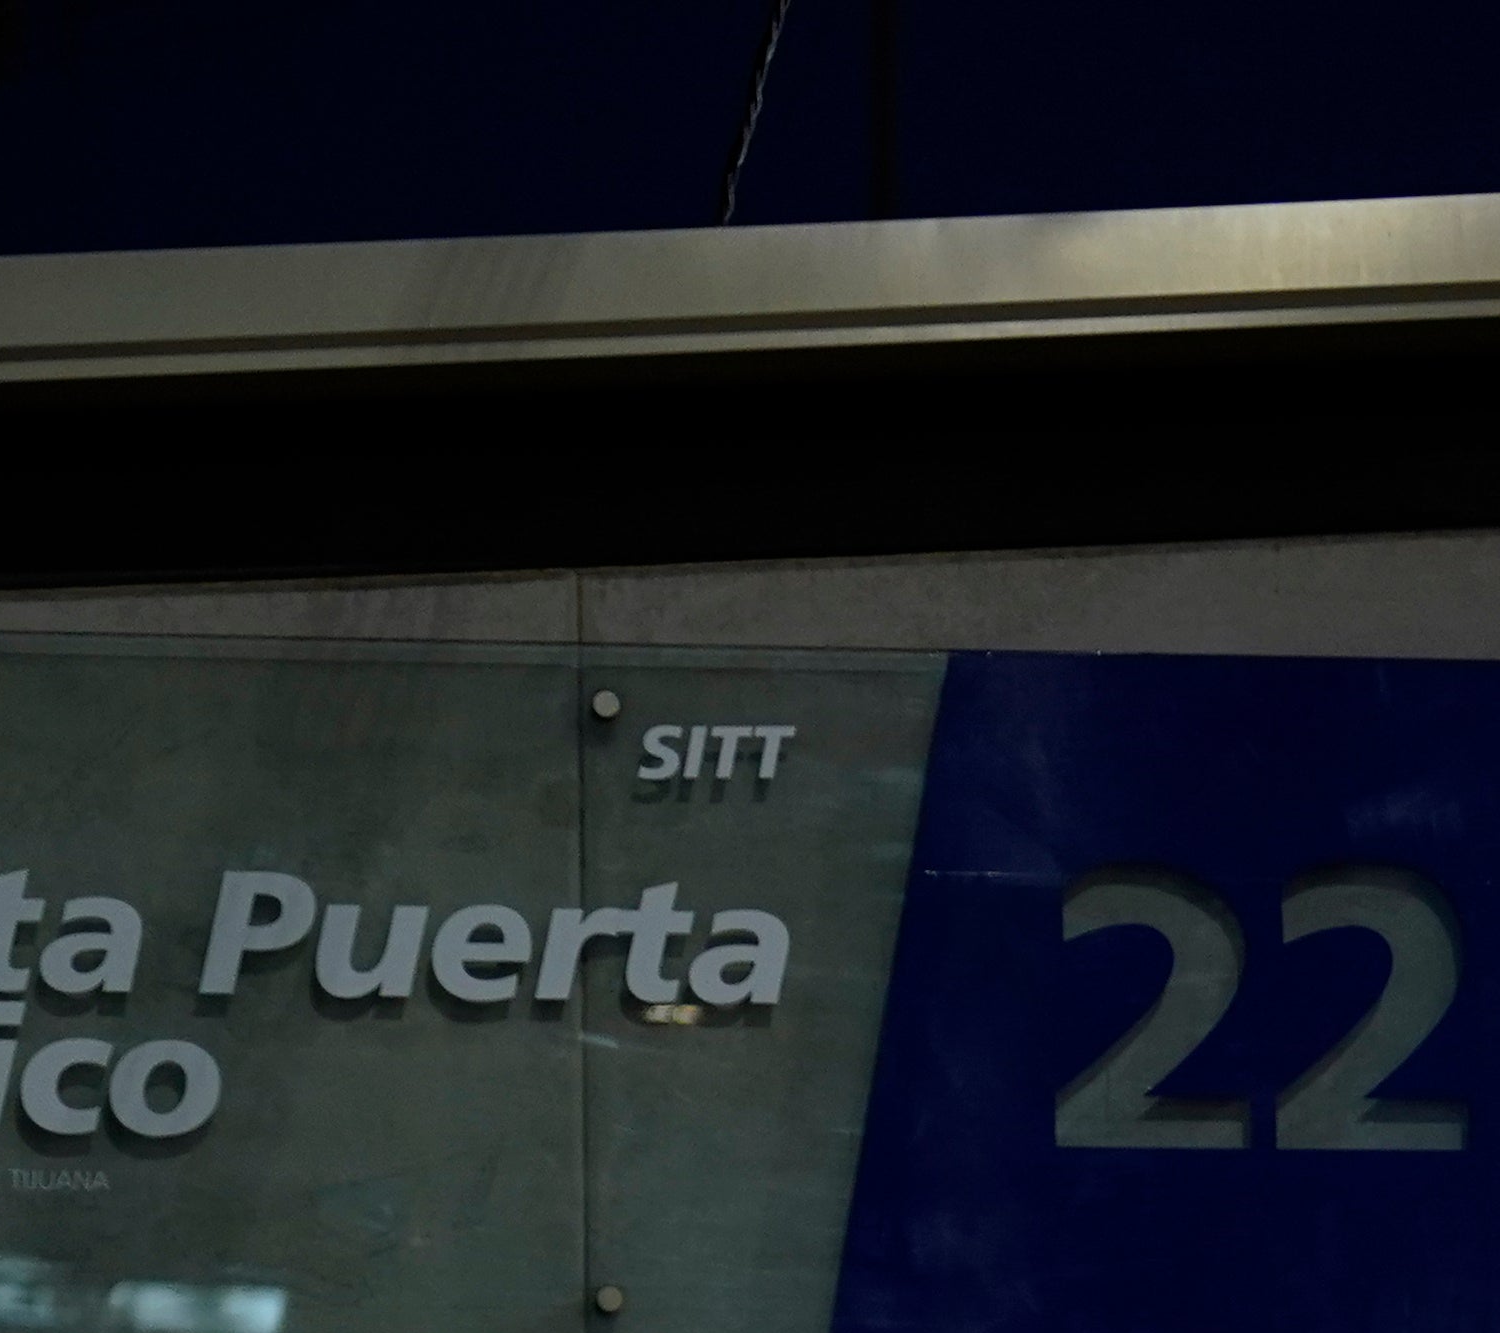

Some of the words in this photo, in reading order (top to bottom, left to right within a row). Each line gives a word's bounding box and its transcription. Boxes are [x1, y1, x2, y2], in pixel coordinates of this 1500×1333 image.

[638, 722, 796, 782] SITT
[199, 868, 792, 1006] Puerta
[1055, 858, 1470, 1152] 22
[7, 1168, 112, 1192] TIJUANA
